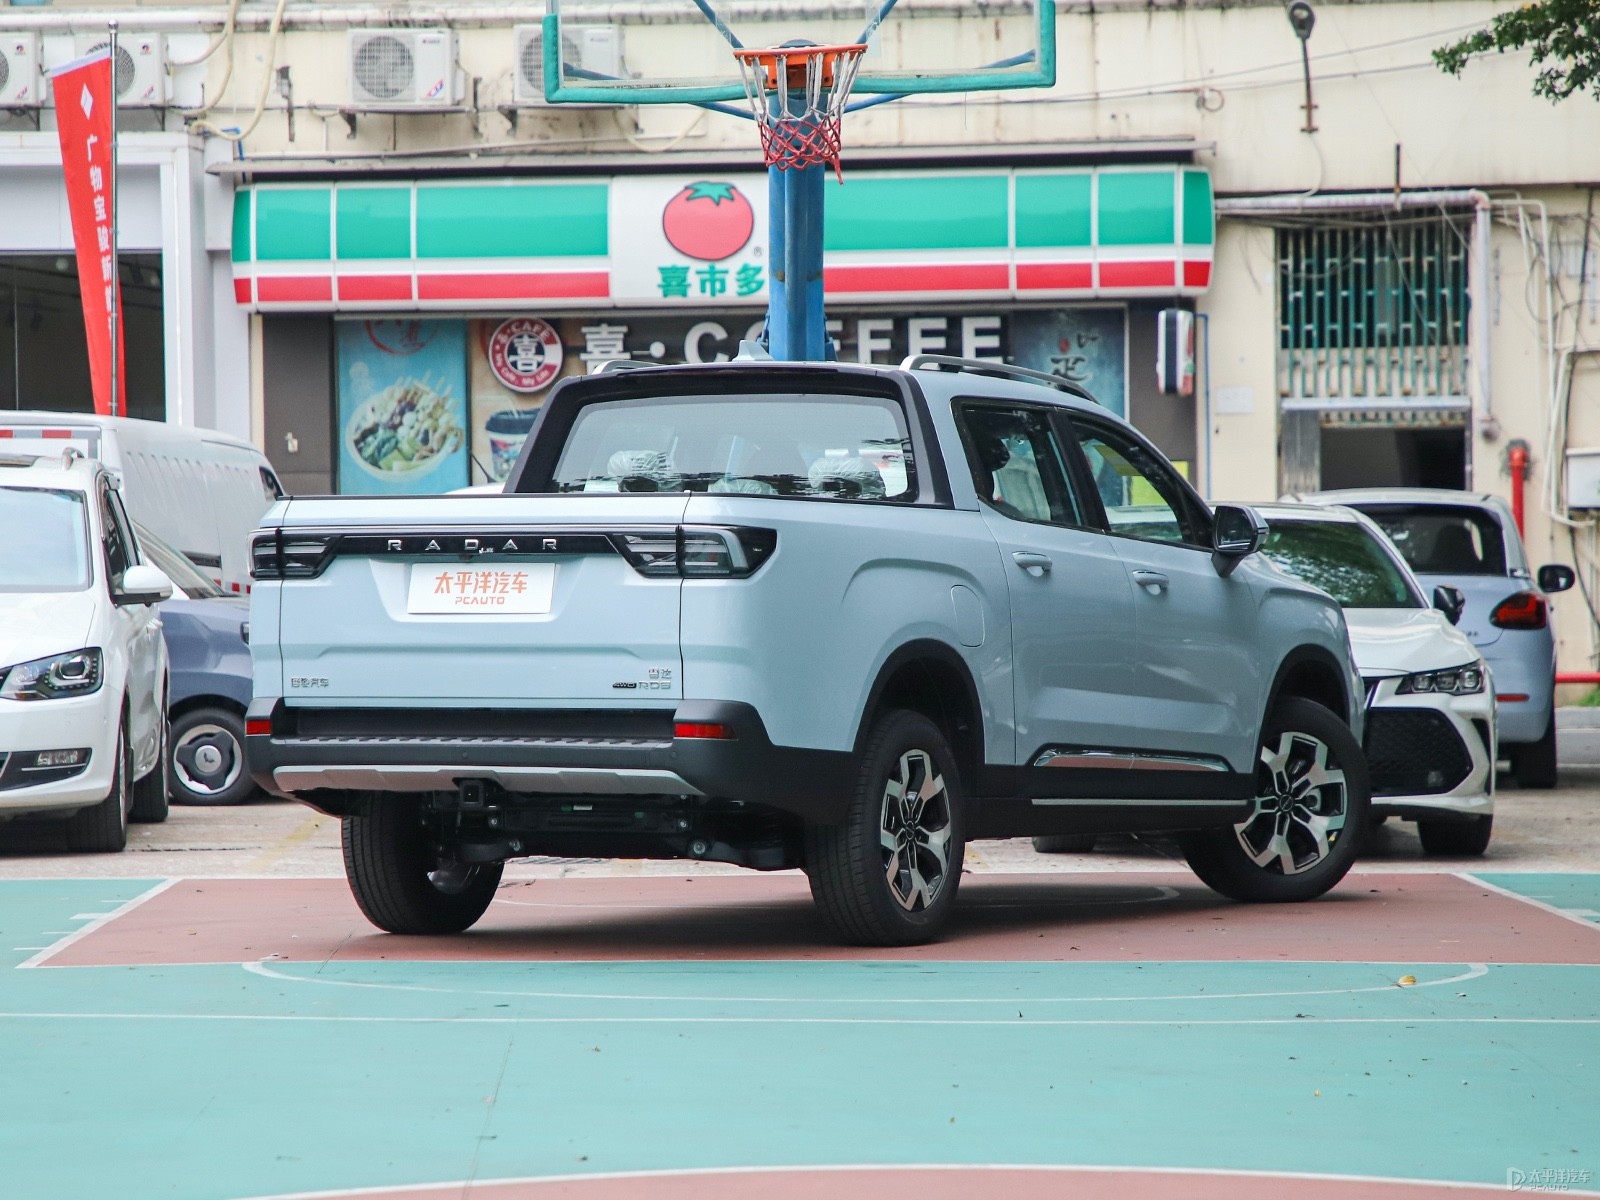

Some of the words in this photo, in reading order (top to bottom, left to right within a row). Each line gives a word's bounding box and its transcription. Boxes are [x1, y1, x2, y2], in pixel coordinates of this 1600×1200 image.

[657, 263, 765, 298] 喜市多
[508, 333, 545, 373] 喜
[387, 538, 557, 551] RADAR
[433, 571, 529, 594] 太平洋汽车
[454, 596, 505, 605] PCAUTO
